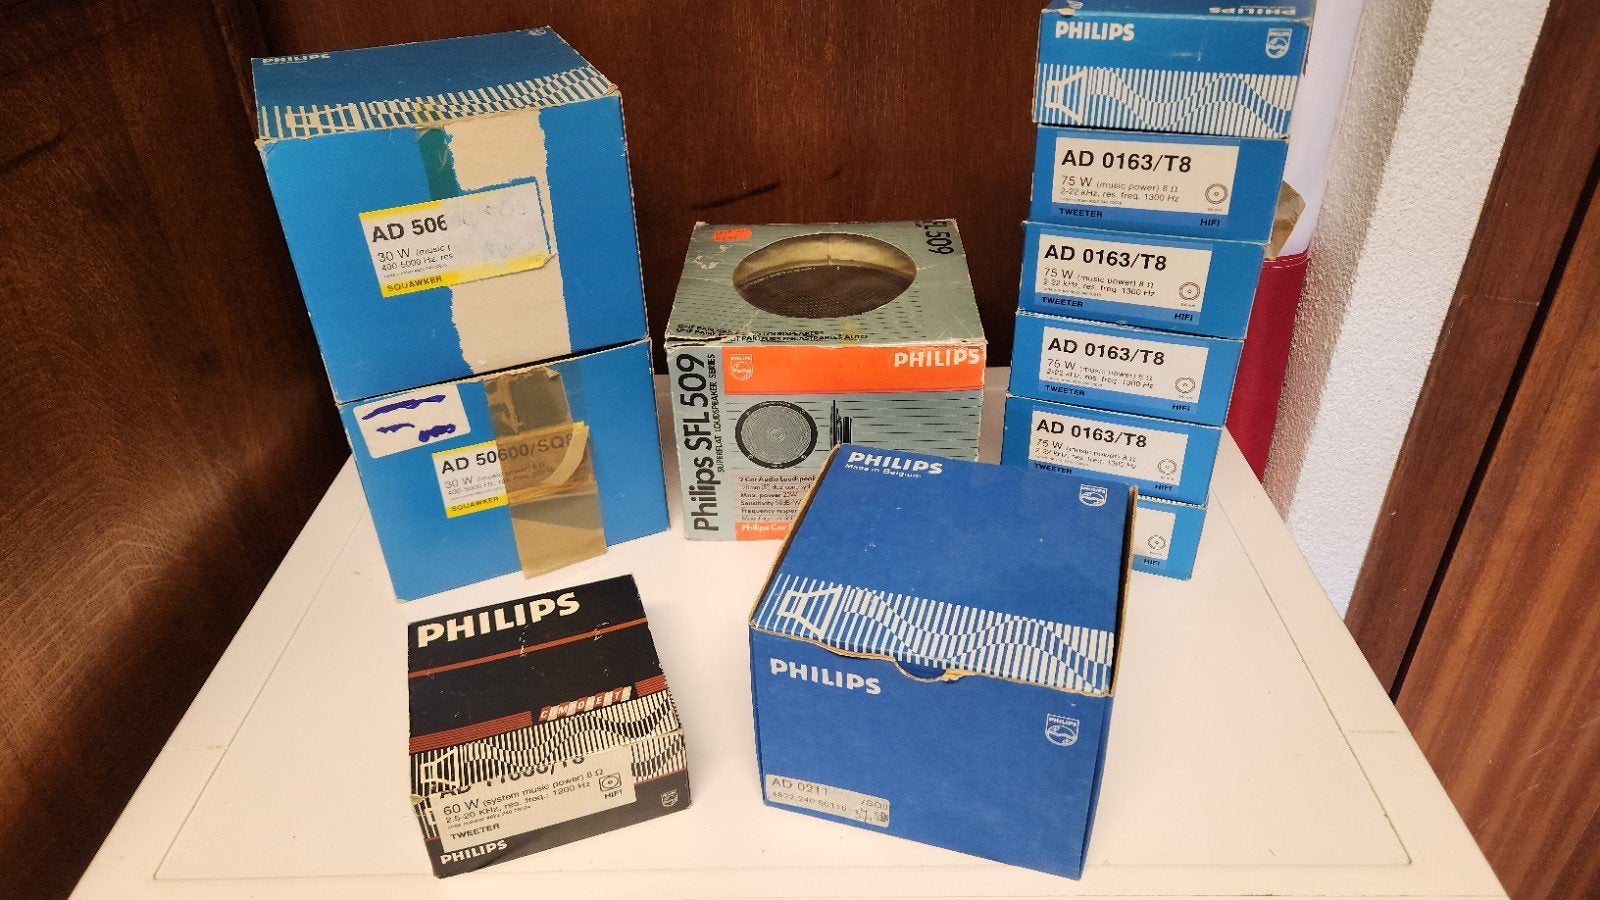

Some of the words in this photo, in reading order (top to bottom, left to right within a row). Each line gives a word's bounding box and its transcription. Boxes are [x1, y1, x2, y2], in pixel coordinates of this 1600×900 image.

[1055, 20, 1135, 41] PHILIPS
[1062, 150, 1094, 167] AD
[1102, 152, 1192, 173] 0163/T8
[1061, 175, 1076, 187] 75
[1080, 176, 1093, 187] W
[1096, 180, 1126, 190] (music
[1128, 183, 1160, 192] power)
[1060, 187, 1079, 196] 2-22
[1144, 193, 1164, 202] 1300
[1167, 195, 1180, 203] Hz
[1059, 207, 1103, 218] TWEETER
[1200, 218, 1220, 227] HIFI
[372, 223, 404, 242] AD
[926, 230, 955, 255] 509
[377, 251, 394, 263] 30
[396, 247, 410, 258] W
[1044, 244, 1075, 261] AD
[1083, 249, 1167, 271] 0163/T8
[1044, 268, 1058, 277] 75
[1061, 270, 1074, 280] W
[387, 275, 443, 292] SQUAWKER
[1042, 296, 1083, 308] TWEETER
[1174, 313, 1194, 321] HIFI
[894, 349, 981, 368] PHILIPS
[1048, 338, 1078, 354] AD
[1085, 342, 1165, 366] 0163/T8
[707, 353, 717, 379] SERIES
[1048, 358, 1061, 368] 75
[1064, 361, 1076, 370] W
[676, 353, 709, 408] 509
[1045, 384, 1085, 396] TWEETER
[709, 381, 722, 433] LOUDSPEAKER
[1172, 403, 1190, 412] HIFI
[682, 411, 713, 451] SFL
[1037, 419, 1064, 434] AD
[1071, 424, 1147, 448] 0163/T8
[714, 435, 725, 473] SUPERFLAT
[1052, 441, 1064, 450] W
[442, 456, 469, 474] AD
[845, 463, 869, 472] Made
[882, 468, 922, 479] Belgium
[847, 451, 943, 475] PHILIPS
[1034, 462, 1072, 474] TWEETER
[445, 478, 459, 489] 30
[463, 475, 474, 485] W
[1154, 483, 1172, 492] HIFI
[689, 456, 721, 531] Philips
[451, 496, 499, 512] SQUAWKER
[741, 523, 770, 532] Philips
[1143, 558, 1160, 567] HIFI
[417, 591, 581, 648] PHILIPS
[770, 657, 882, 695] PHILIPS
[553, 783, 576, 796] 1200
[578, 781, 591, 789] Hz
[772, 778, 792, 789] AD
[443, 803, 461, 816] 60
[464, 798, 479, 811] W
[483, 791, 520, 808] (system
[522, 783, 550, 796] music
[552, 774, 584, 789] power)
[604, 789, 623, 799] HIFI
[798, 795, 816, 804] 240
[450, 823, 500, 840] TWEETER
[440, 839, 509, 865] PHILIPS
